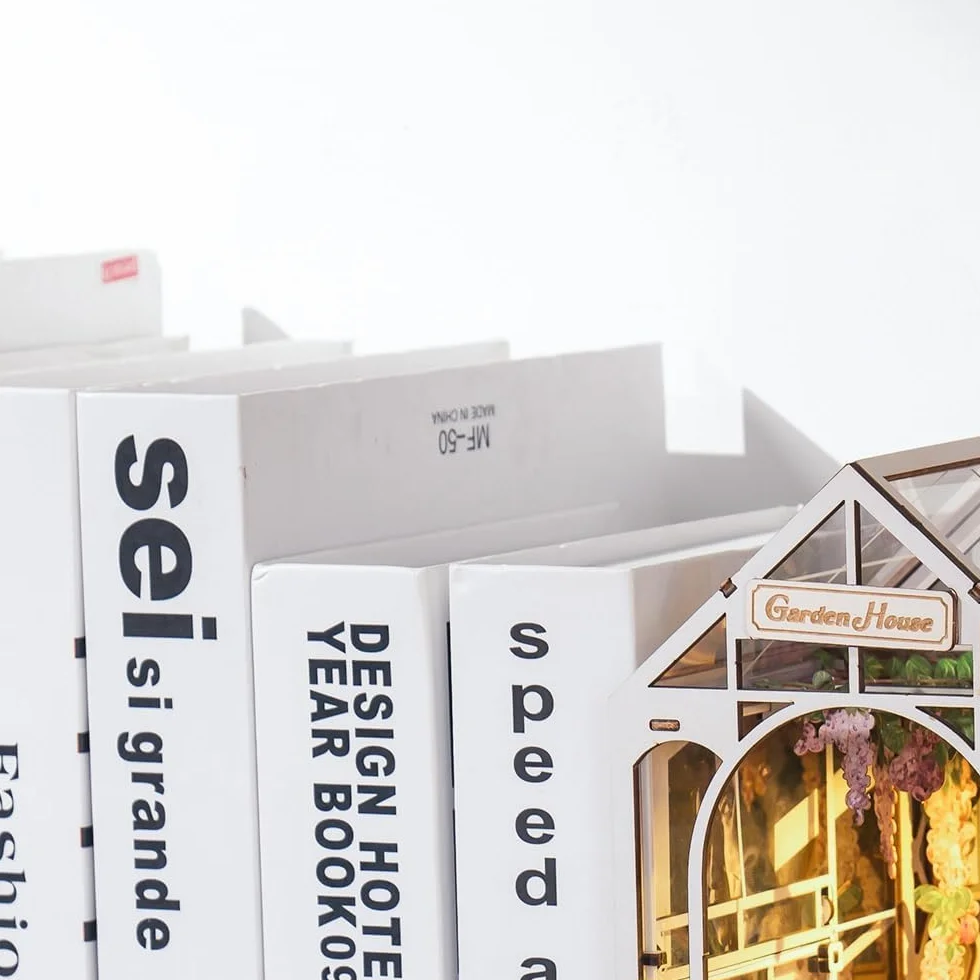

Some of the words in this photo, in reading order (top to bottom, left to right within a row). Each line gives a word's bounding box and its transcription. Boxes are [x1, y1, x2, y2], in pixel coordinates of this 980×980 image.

[431, 408, 458, 425] CHINA
[459, 407, 469, 420] IN
[471, 404, 496, 420] MADE
[438, 423, 490, 455] MF-50
[114, 434, 218, 641] sei
[764, 593, 850, 627] Garden
[851, 601, 934, 632] House
[126, 657, 173, 710] si
[307, 621, 350, 759] YEAR
[349, 623, 397, 816] DESIGN
[509, 622, 558, 907] speed
[117, 731, 181, 951] grande
